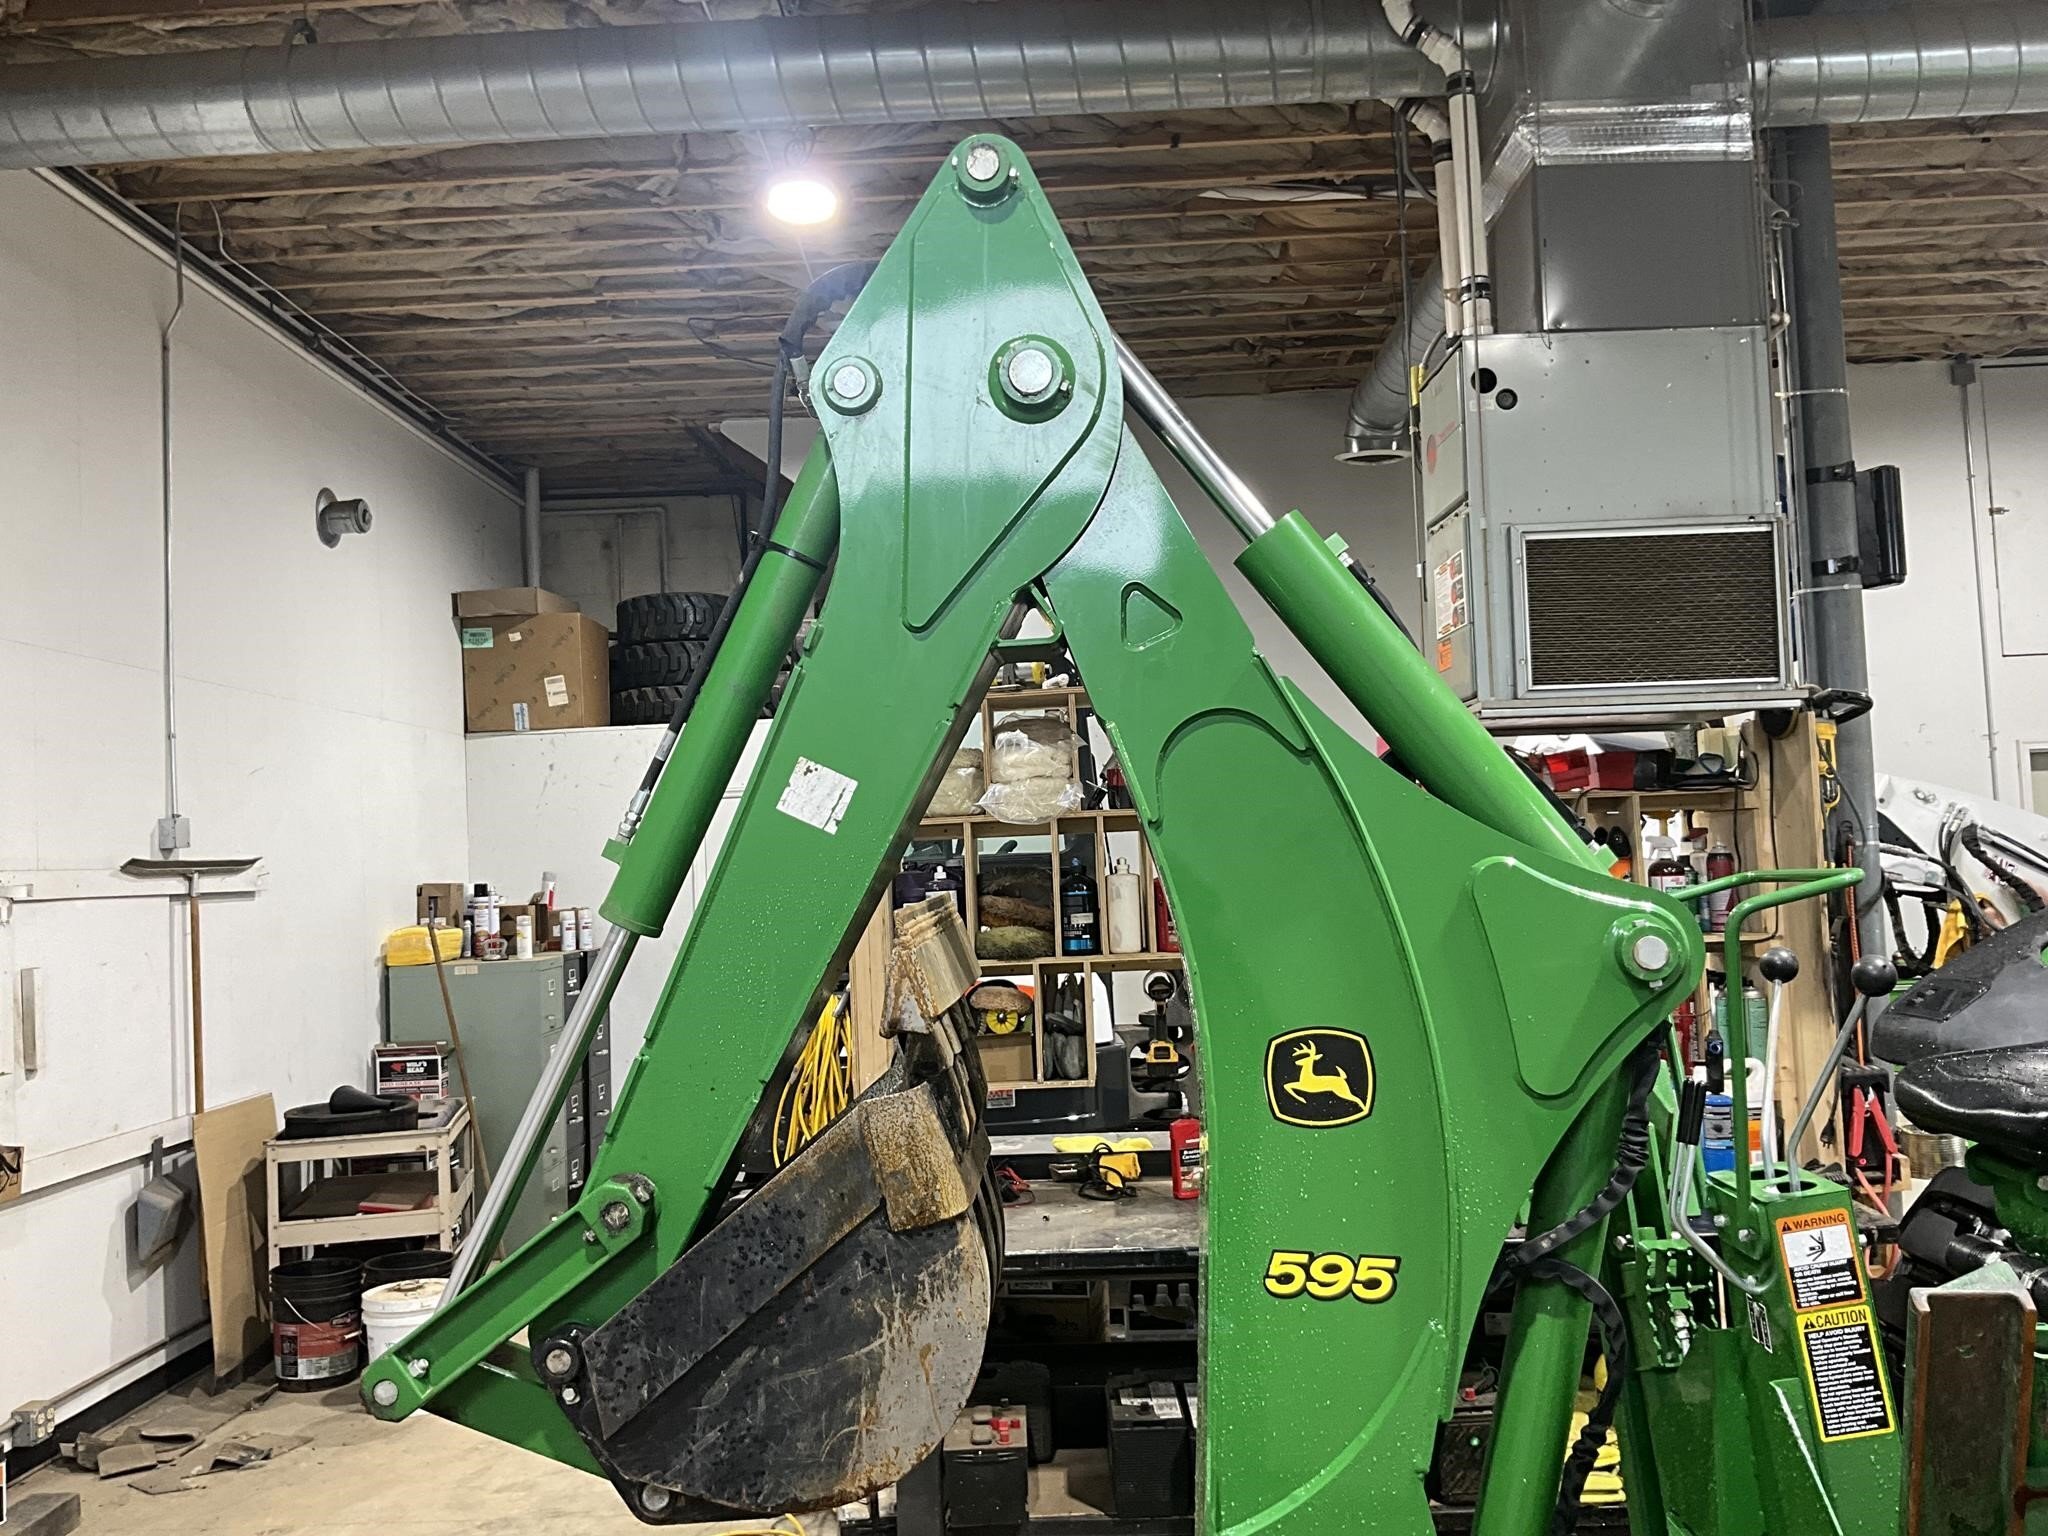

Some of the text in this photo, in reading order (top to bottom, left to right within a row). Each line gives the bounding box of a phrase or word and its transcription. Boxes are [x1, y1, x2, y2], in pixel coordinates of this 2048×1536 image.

[1793, 1213, 1846, 1230] WARNING
[1264, 1249, 1401, 1304] 595
[1816, 1309, 1867, 1328] CAUTION
[1807, 1324, 1866, 1339] HELP AVOID INJURY
